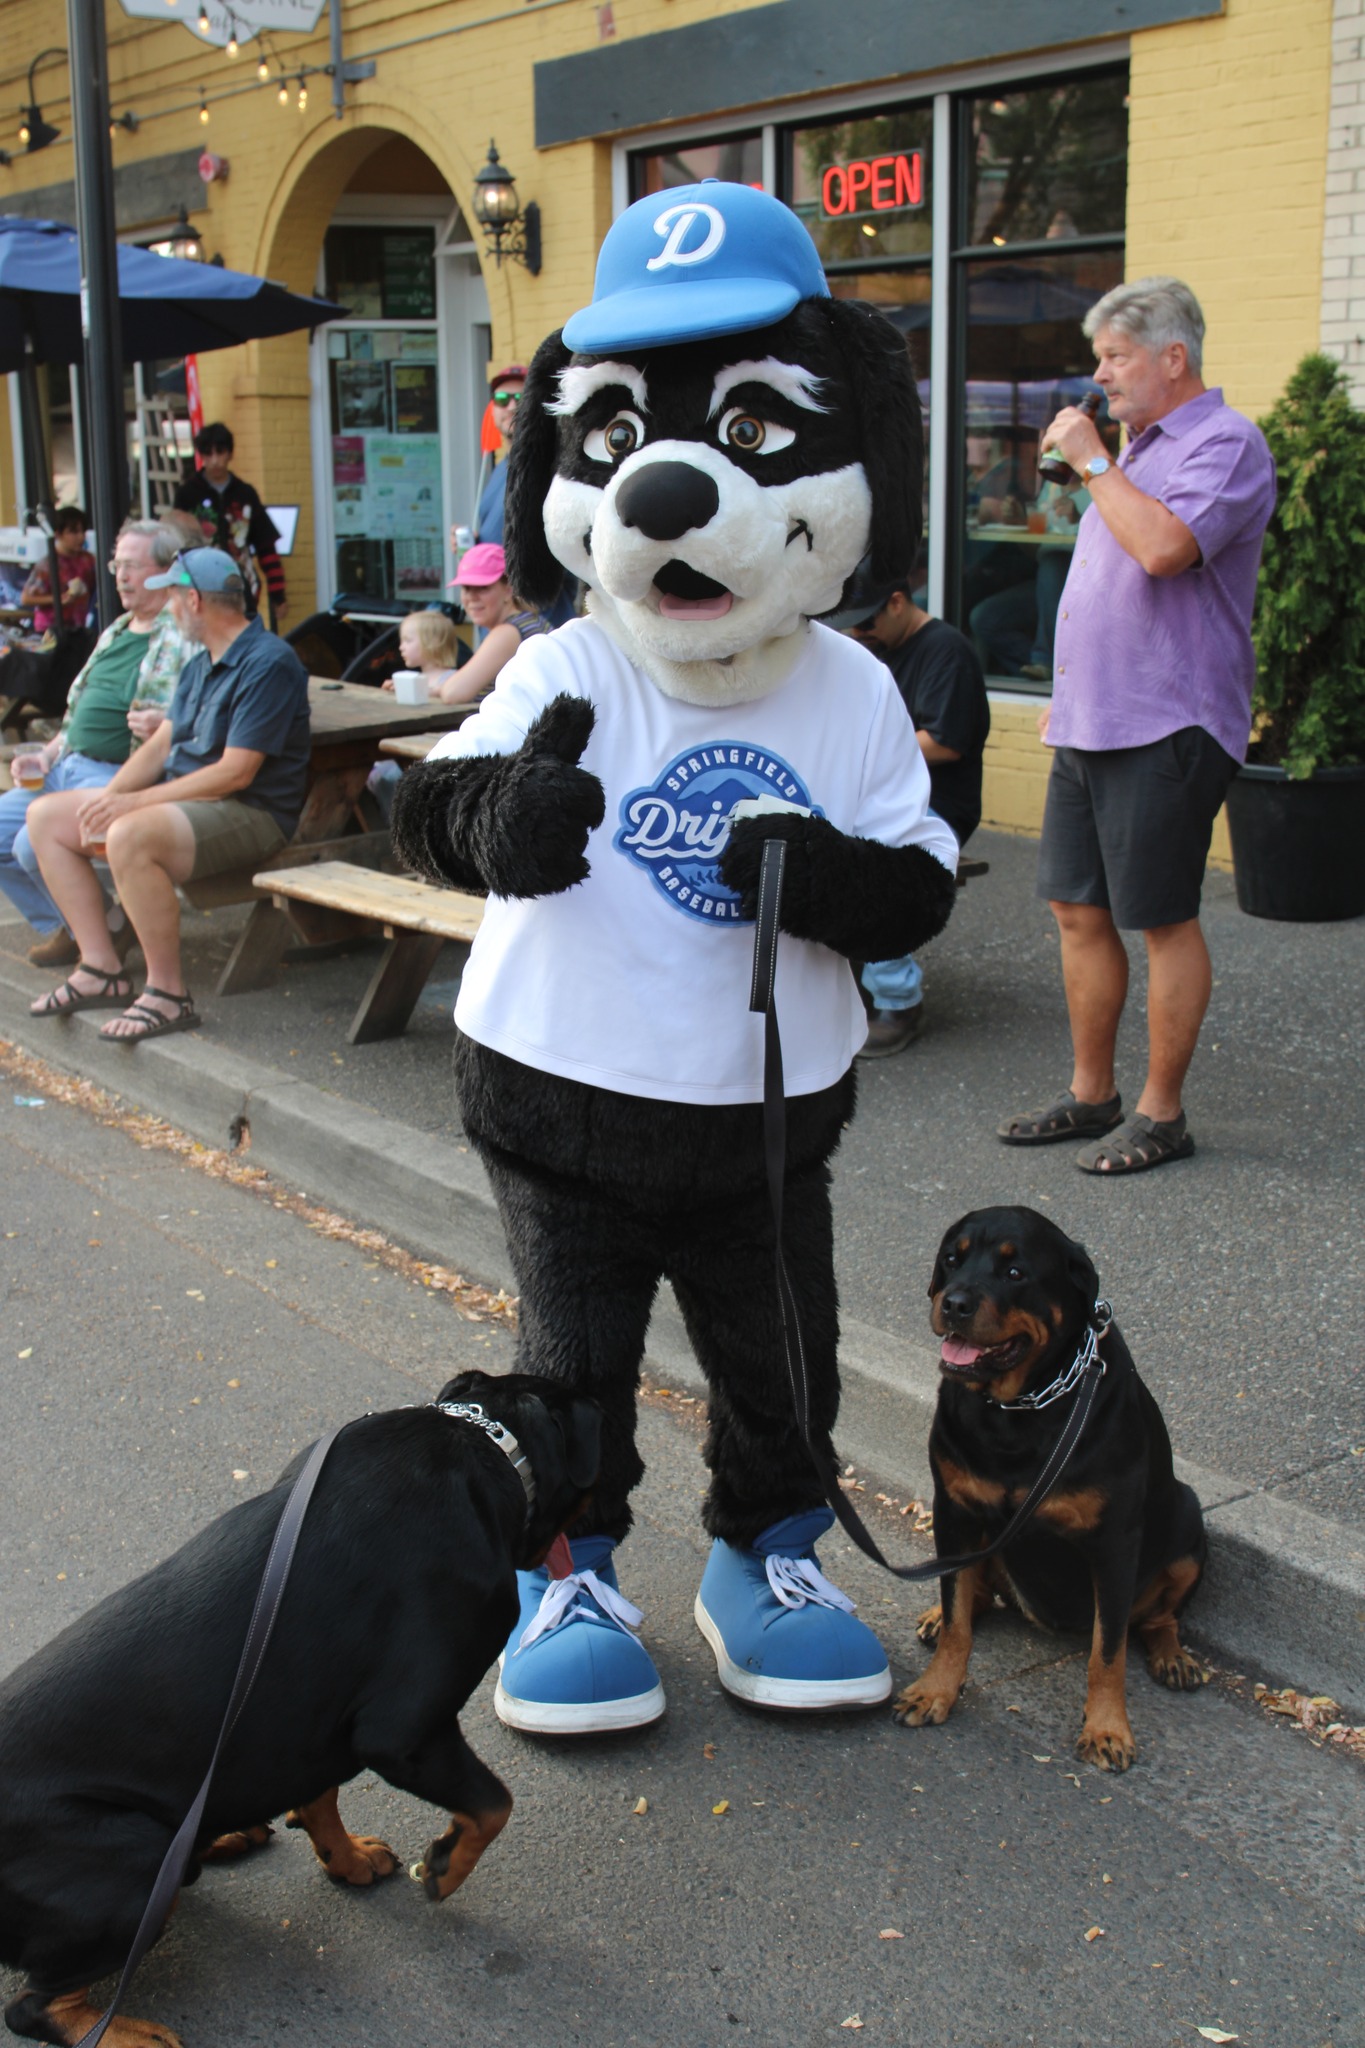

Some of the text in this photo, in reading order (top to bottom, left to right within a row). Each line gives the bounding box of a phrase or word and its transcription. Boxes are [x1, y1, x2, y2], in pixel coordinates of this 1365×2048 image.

[822, 153, 921, 216] OPEN
[646, 203, 726, 271] D
[666, 749, 797, 797] SPRINGFIELD
[624, 797, 738, 858] Drif
[658, 866, 739, 917] BASEBAL
